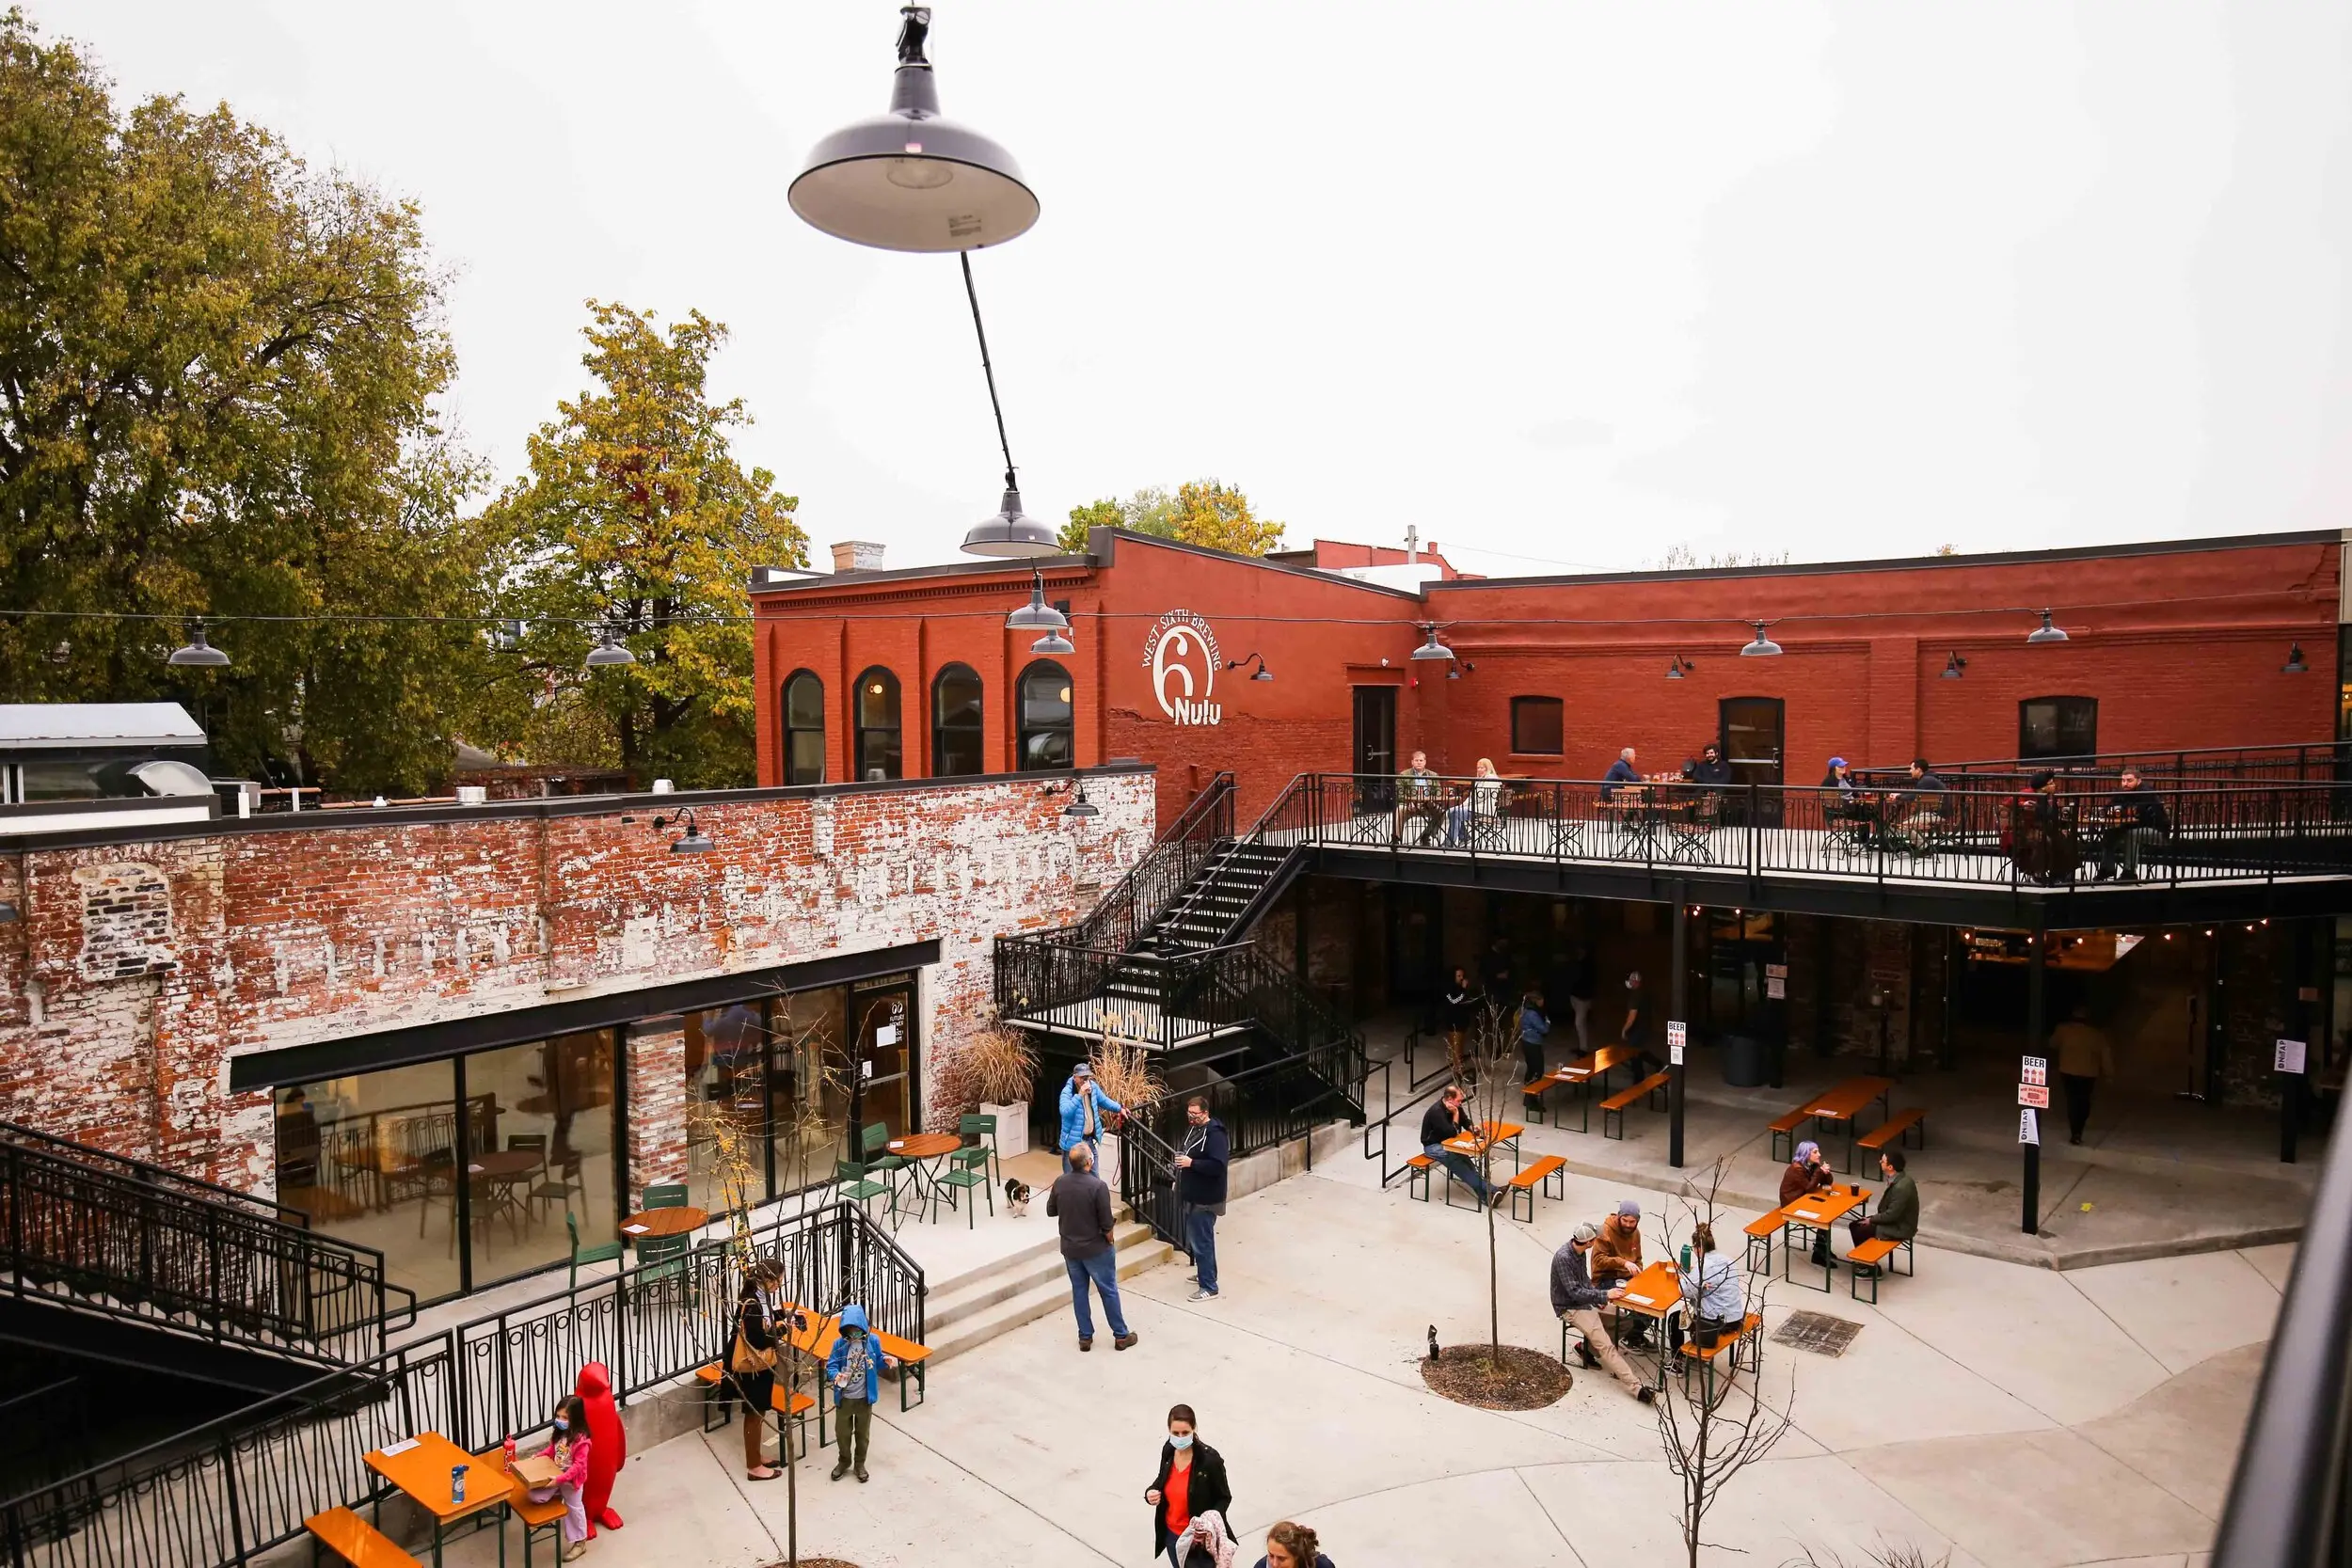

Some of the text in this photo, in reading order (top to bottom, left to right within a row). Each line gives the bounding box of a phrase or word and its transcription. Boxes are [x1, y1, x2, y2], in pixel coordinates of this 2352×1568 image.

[1141, 608, 1222, 672] WEST SIXTH BREWING
[1669, 1022, 1685, 1031] BEER
[2024, 1056, 2045, 1068] BEER
[2021, 1128, 2027, 1140] ON
